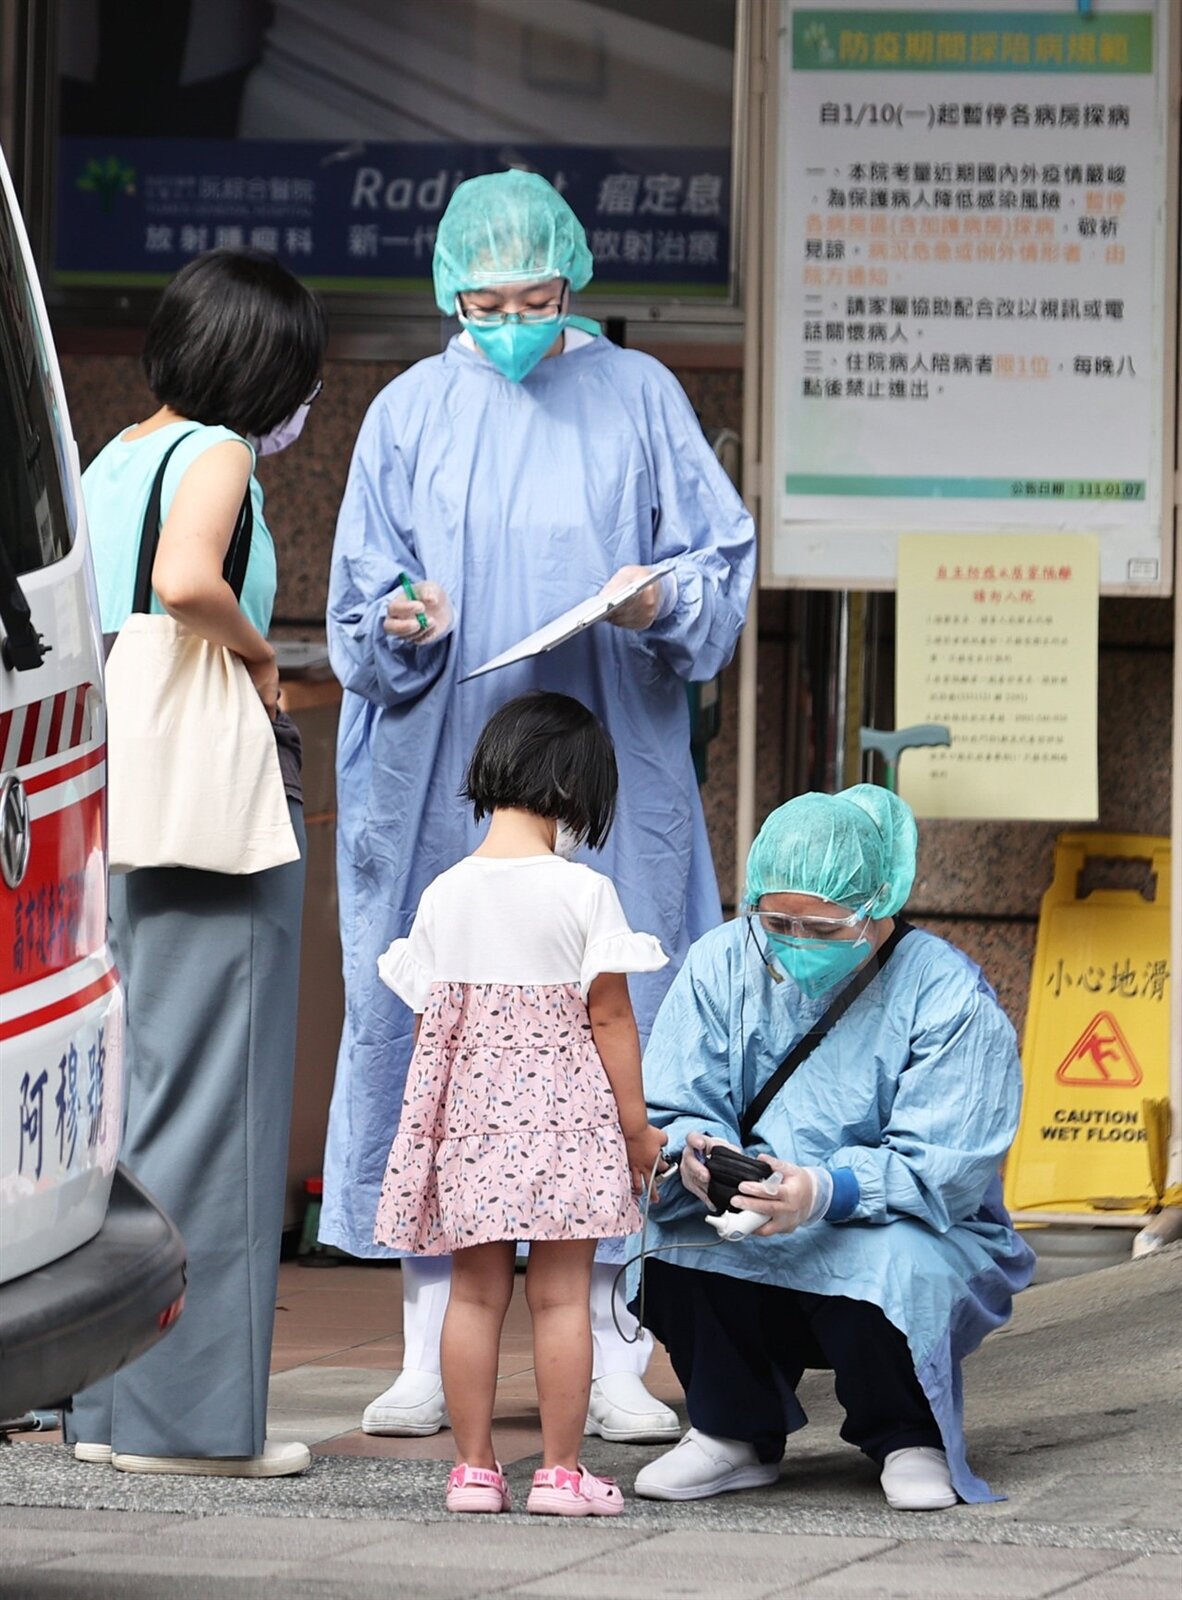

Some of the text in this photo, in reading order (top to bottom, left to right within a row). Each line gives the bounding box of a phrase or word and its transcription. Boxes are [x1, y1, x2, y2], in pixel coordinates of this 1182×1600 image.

[1046, 958, 1171, 1002] 小心地滑
[1054, 1109, 1139, 1125] CAUTION
[1040, 1127, 1080, 1141] WET
